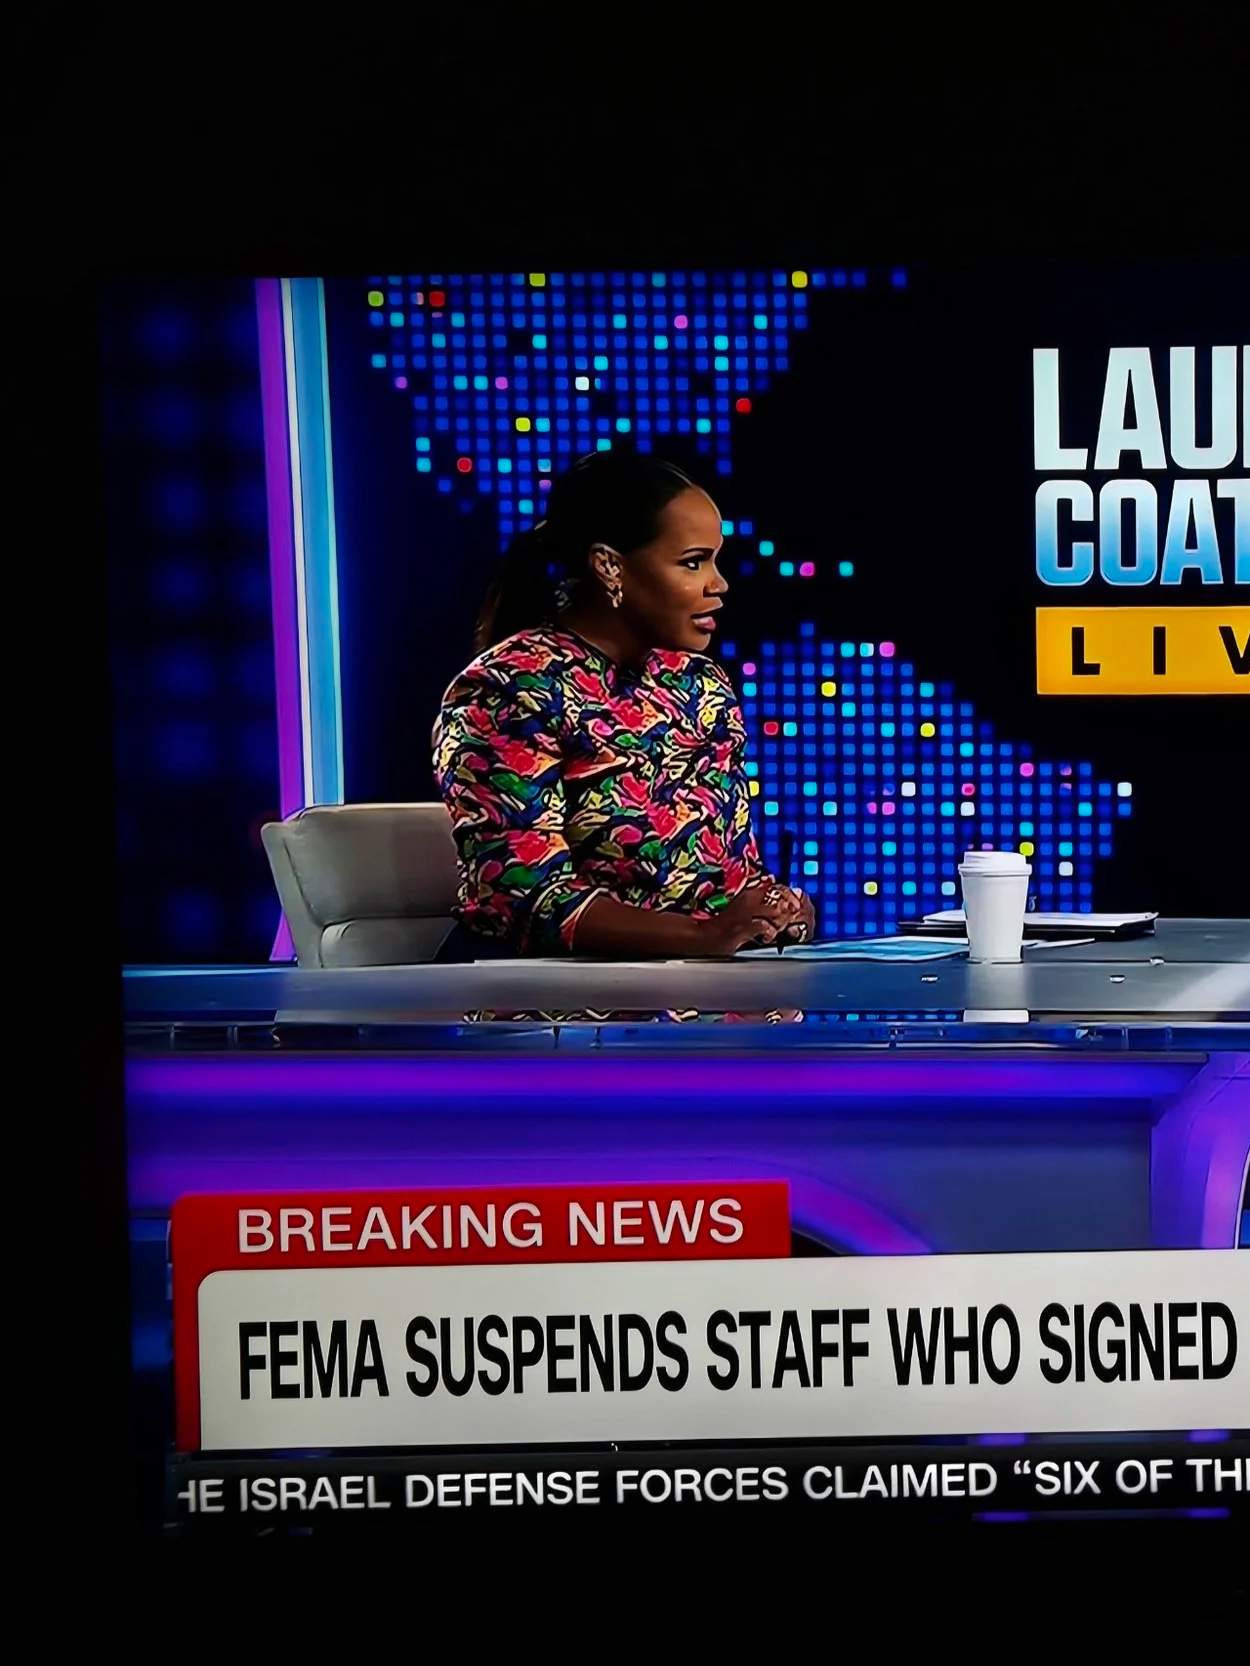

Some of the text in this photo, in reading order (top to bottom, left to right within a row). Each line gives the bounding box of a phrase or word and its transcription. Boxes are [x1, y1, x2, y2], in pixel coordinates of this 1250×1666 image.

[238, 1198, 744, 1253] BREAKING NEWS
[238, 1318, 390, 1401] FEMA
[405, 1310, 690, 1398] SUSPENDS
[706, 1308, 870, 1392] STAFF
[886, 1303, 1021, 1386] WHO
[1038, 1301, 1238, 1385] SIGNED
[240, 1475, 391, 1511] ISRAEL
[405, 1470, 601, 1508] DEFENSE
[616, 1466, 789, 1503] FORCES
[803, 1462, 998, 1500] CLAIMED
[1013, 1459, 1101, 1496] “SIX
[1115, 1459, 1174, 1494] OF
